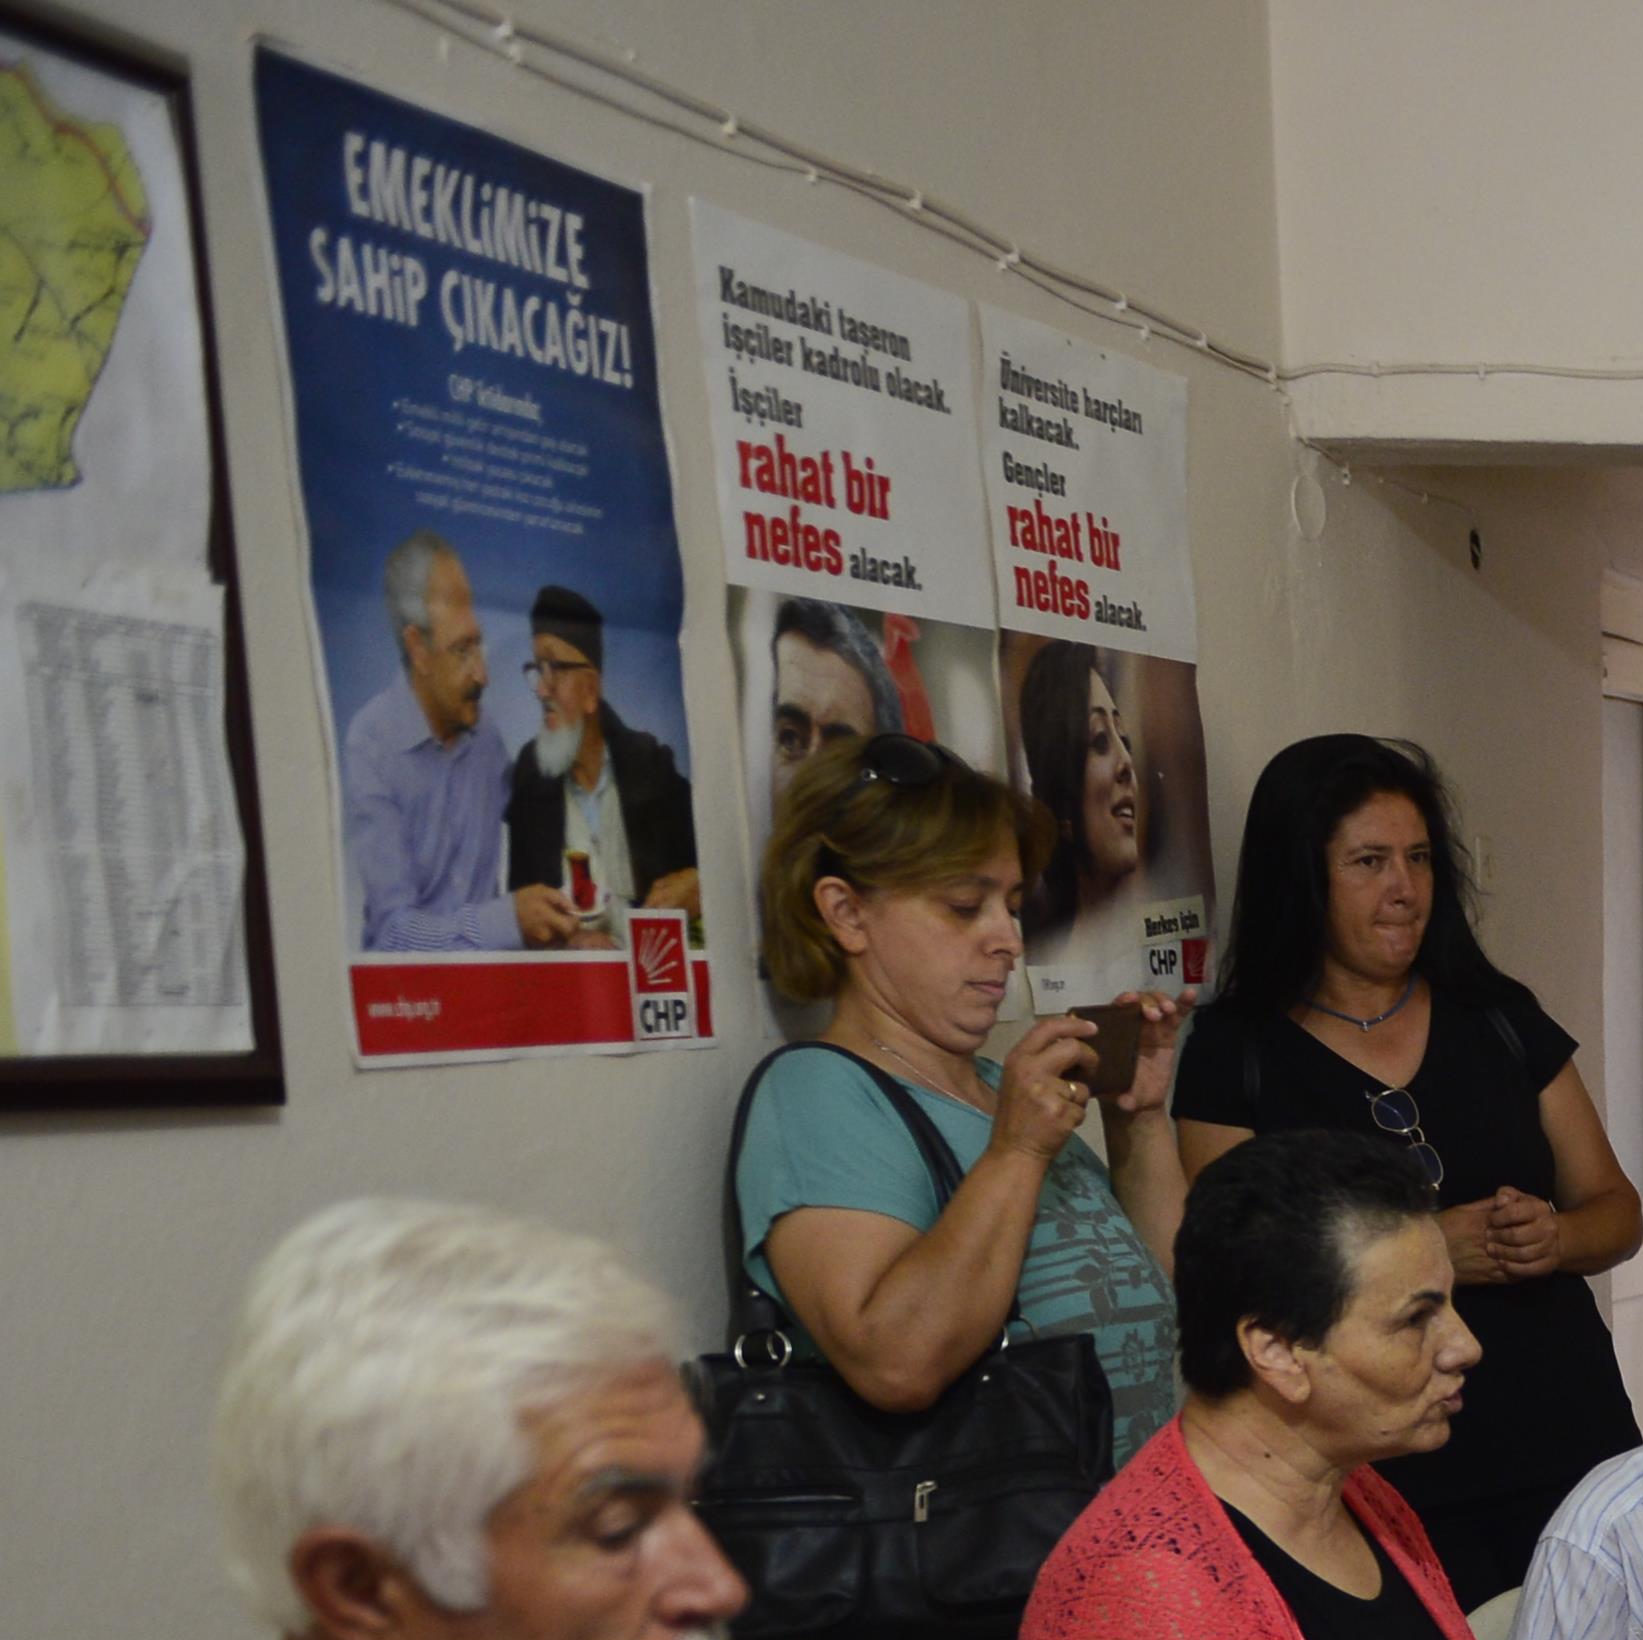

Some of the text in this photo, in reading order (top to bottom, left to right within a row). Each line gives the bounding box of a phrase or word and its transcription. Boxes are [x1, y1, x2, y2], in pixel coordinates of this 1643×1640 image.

[440, 268, 635, 389] ÇIKACAĞIZ!
[718, 264, 912, 362] Kamudaki taşeron
[722, 312, 952, 415] işçiler kadrolu olacak.
[729, 366, 803, 428] İşçiler
[1000, 351, 1143, 435] Üniversite harçları
[998, 396, 1080, 451] kalkacak.
[736, 432, 891, 520] rahat bir
[1002, 450, 1067, 498] Gençler
[743, 504, 922, 590] nefes alacak.
[1006, 498, 1121, 571] rahat bir
[1013, 559, 1147, 632] nefes alacak.
[1149, 949, 1177, 976] CHP
[640, 998, 688, 1034] CHP
